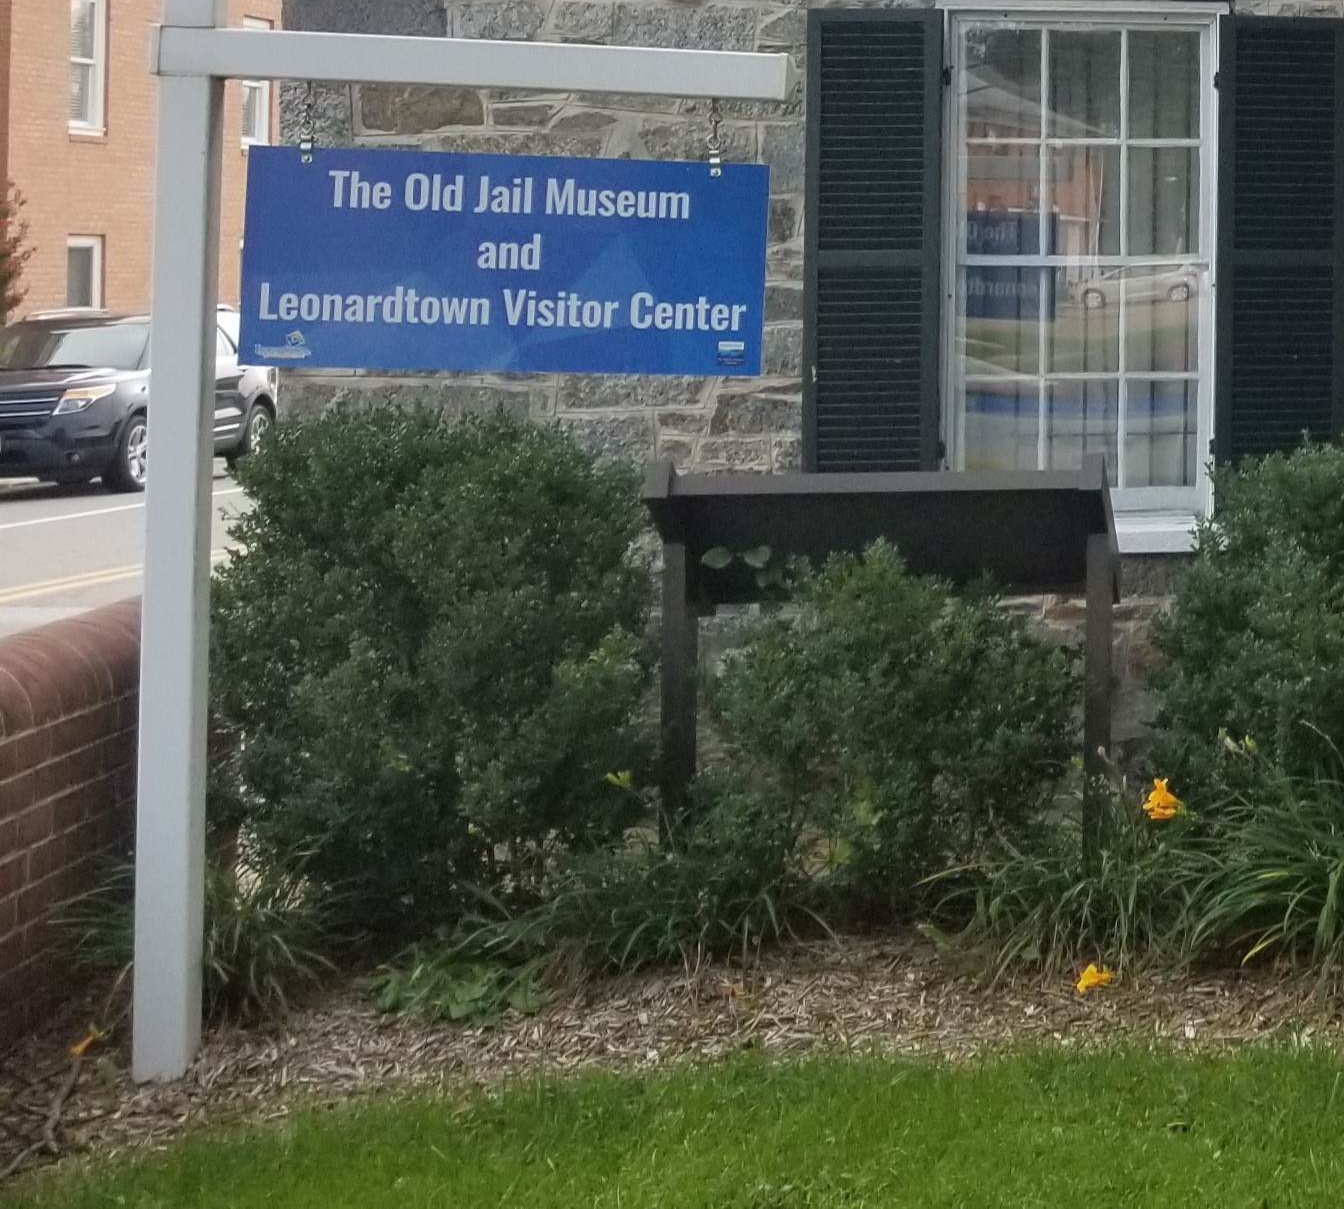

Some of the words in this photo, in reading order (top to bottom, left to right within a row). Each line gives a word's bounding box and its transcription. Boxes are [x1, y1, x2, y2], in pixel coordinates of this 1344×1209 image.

[328, 170, 392, 209] The
[404, 173, 464, 212] Old
[473, 175, 533, 214] Jail
[545, 178, 690, 219] Museum
[477, 233, 541, 270] and
[259, 283, 490, 325] Leonardtown
[503, 288, 619, 328] Visitor
[630, 292, 747, 331] Center
